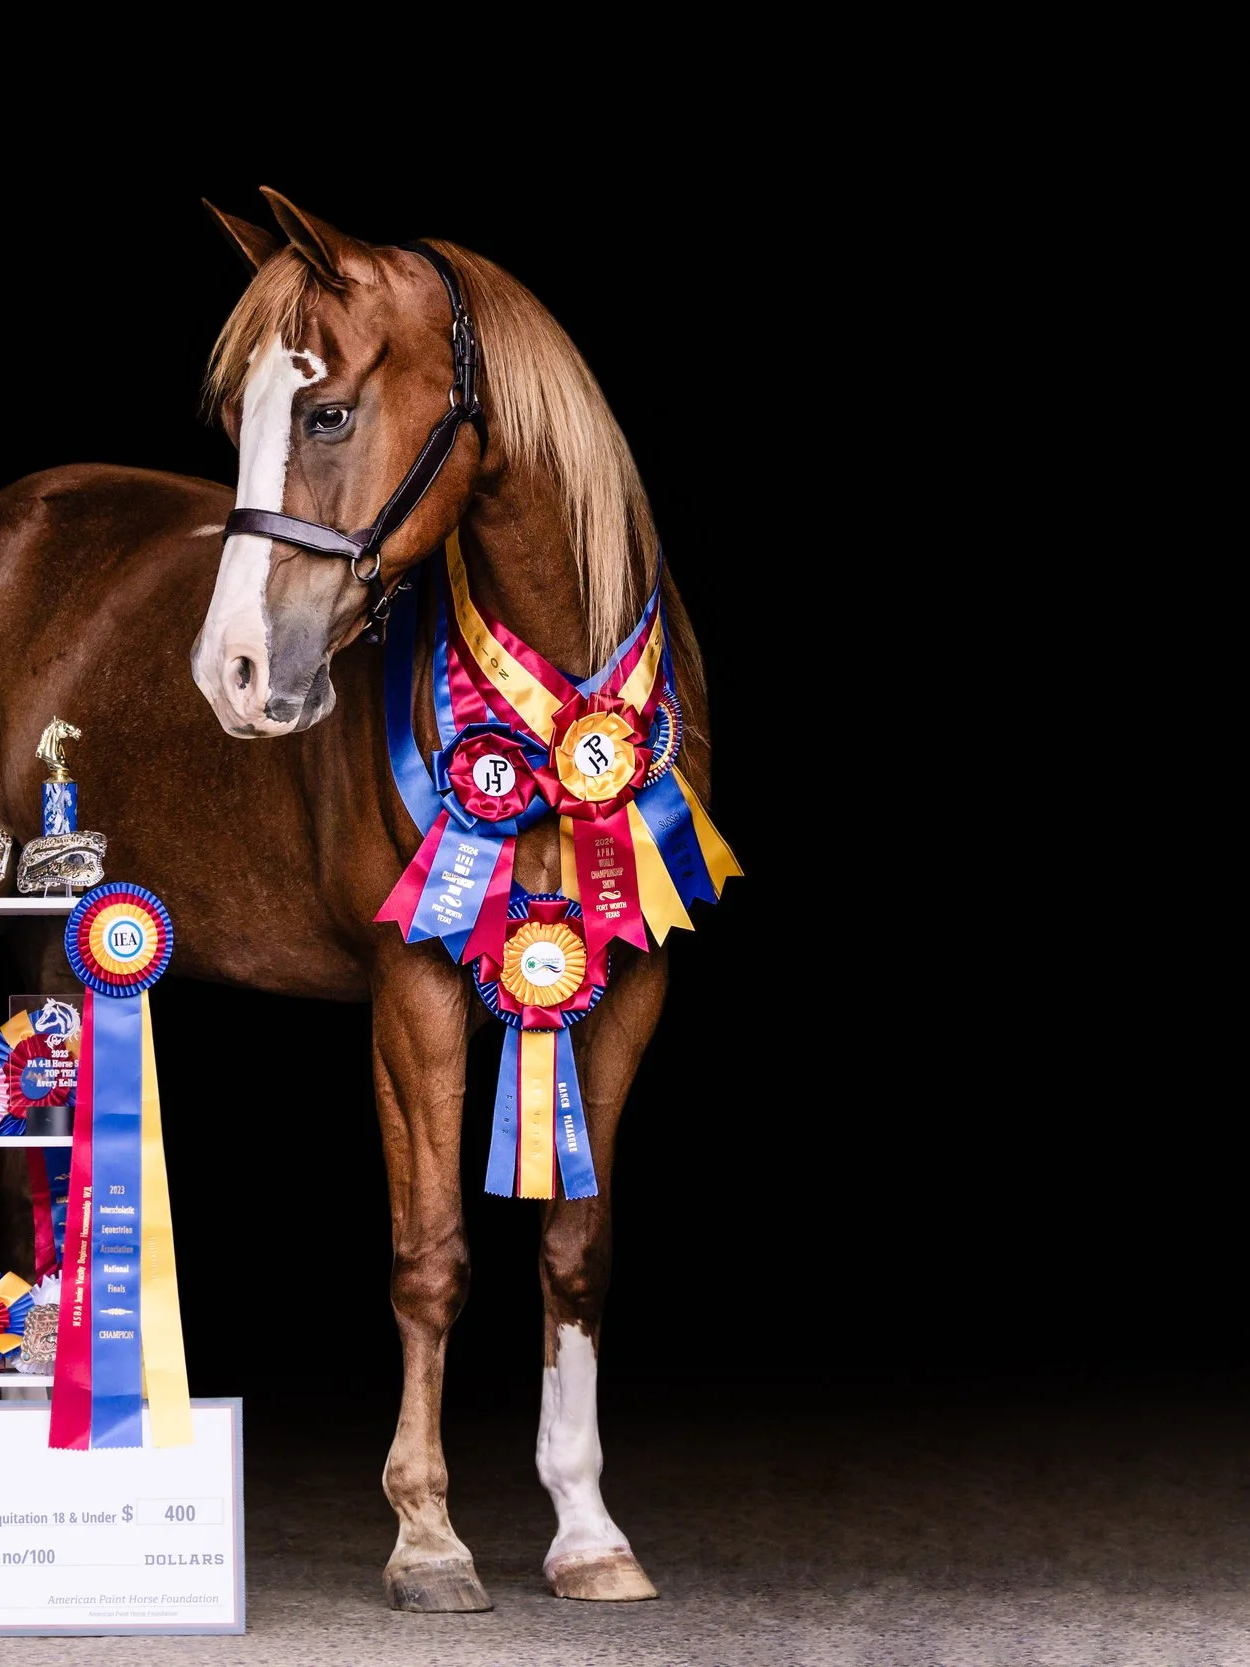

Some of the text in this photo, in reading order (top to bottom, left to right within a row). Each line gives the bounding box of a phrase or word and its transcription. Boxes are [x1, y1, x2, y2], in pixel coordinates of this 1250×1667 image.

[594, 837, 614, 847] 2024
[458, 842, 479, 857] 2024
[590, 867, 624, 880] CHAMPIONSHIP
[602, 879, 616, 889] SHOW
[432, 903, 463, 919] FORT WORTH
[596, 901, 627, 912] FORT WORTH
[437, 914, 453, 924] TEXAS
[605, 911, 620, 919] TEXAS
[113, 932, 138, 947] IEA
[51, 1050, 69, 1058] 2023
[27, 1060, 38, 1068] PA
[38, 1060, 51, 1068] 4-H
[52, 1060, 73, 1068] Horse
[44, 1069, 76, 1077] TOP TEN
[36, 1079, 57, 1089] Avery
[557, 1082, 578, 1152] RANCH PLEASURE
[109, 1185, 125, 1195] 2023
[99, 1205, 135, 1215] Interscholastic
[101, 1225, 133, 1235] Equestrian
[100, 1244, 134, 1254] Association
[72, 1200, 92, 1327] NSBA Junior Varsity Beginner Horsemanship
[103, 1264, 129, 1273] National
[107, 1284, 126, 1293] Finals
[99, 1330, 134, 1339] CHAMPION
[52, 1512, 65, 1524] 18
[69, 1512, 78, 1524] &
[82, 1511, 116, 1524] Under
[121, 1504, 196, 1523] $ 400
[2, 1549, 56, 1565] no/100
[144, 1553, 225, 1565] DOLLARS
[47, 1593, 219, 1604] American Paint Horse Foundation
